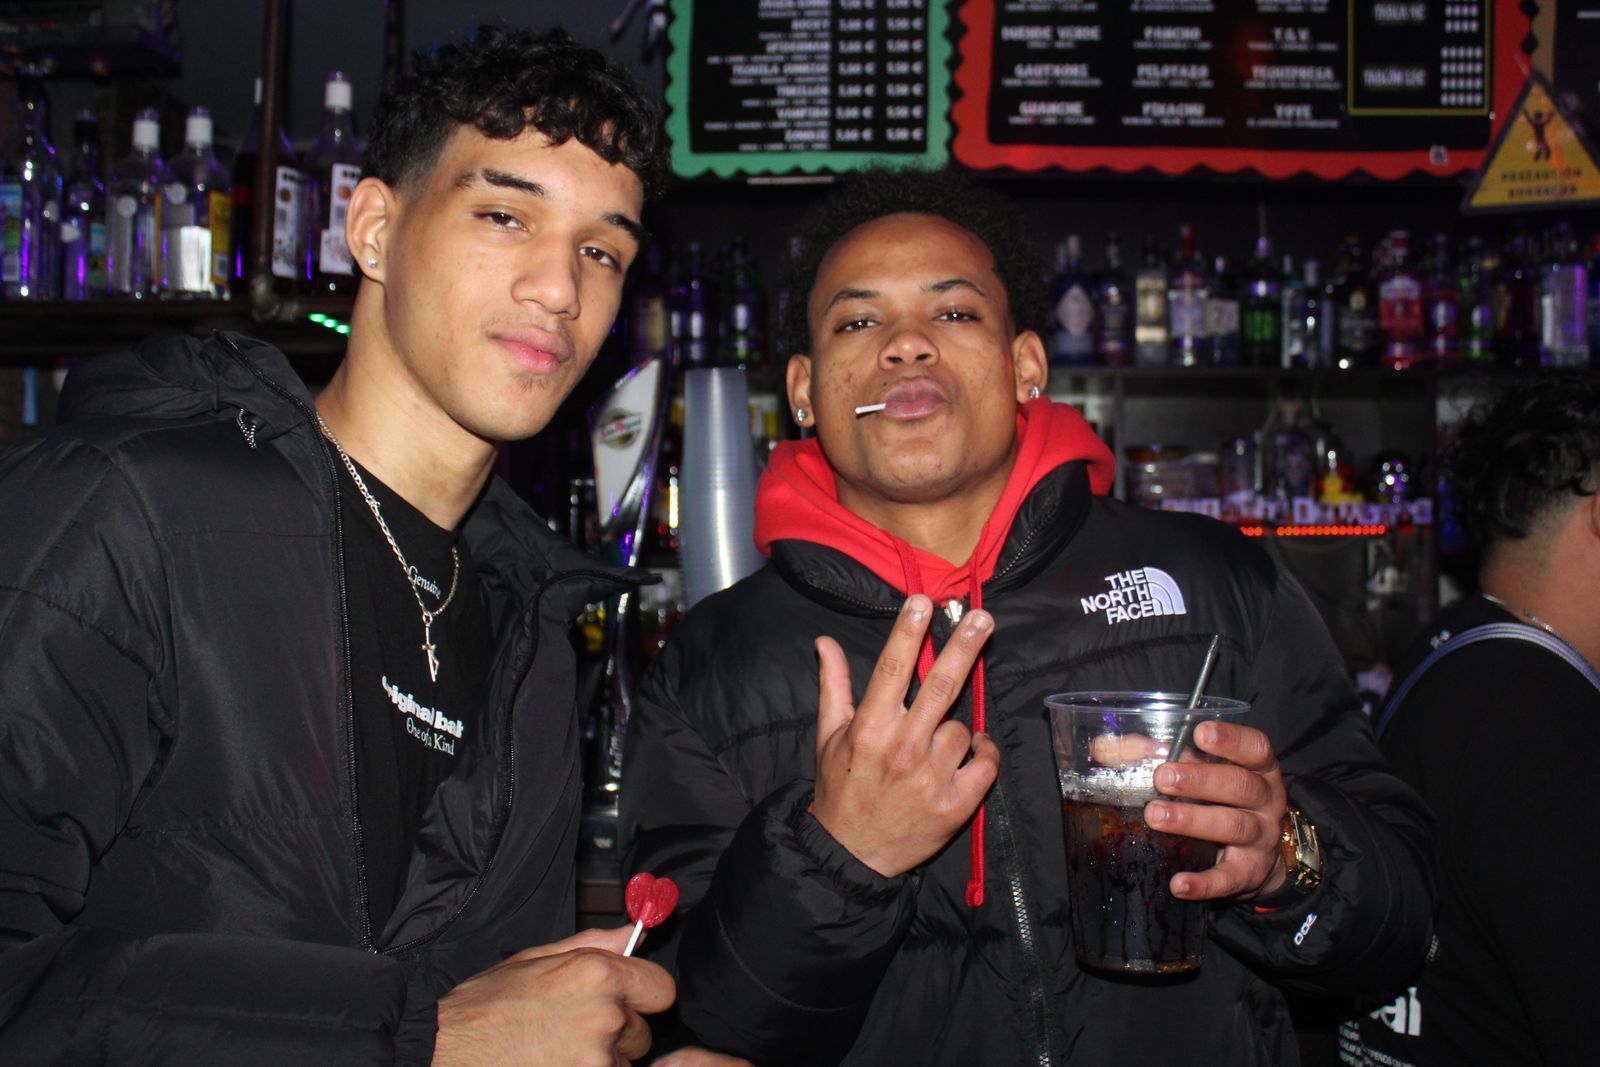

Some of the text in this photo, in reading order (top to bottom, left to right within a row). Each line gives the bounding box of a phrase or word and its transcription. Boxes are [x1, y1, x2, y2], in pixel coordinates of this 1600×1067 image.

[731, 64, 780, 76] TEQUILA
[1104, 569, 1147, 590] THE
[1080, 583, 1151, 615] NORTH
[1106, 600, 1154, 625] FACE
[434, 733, 455, 755] Kind
